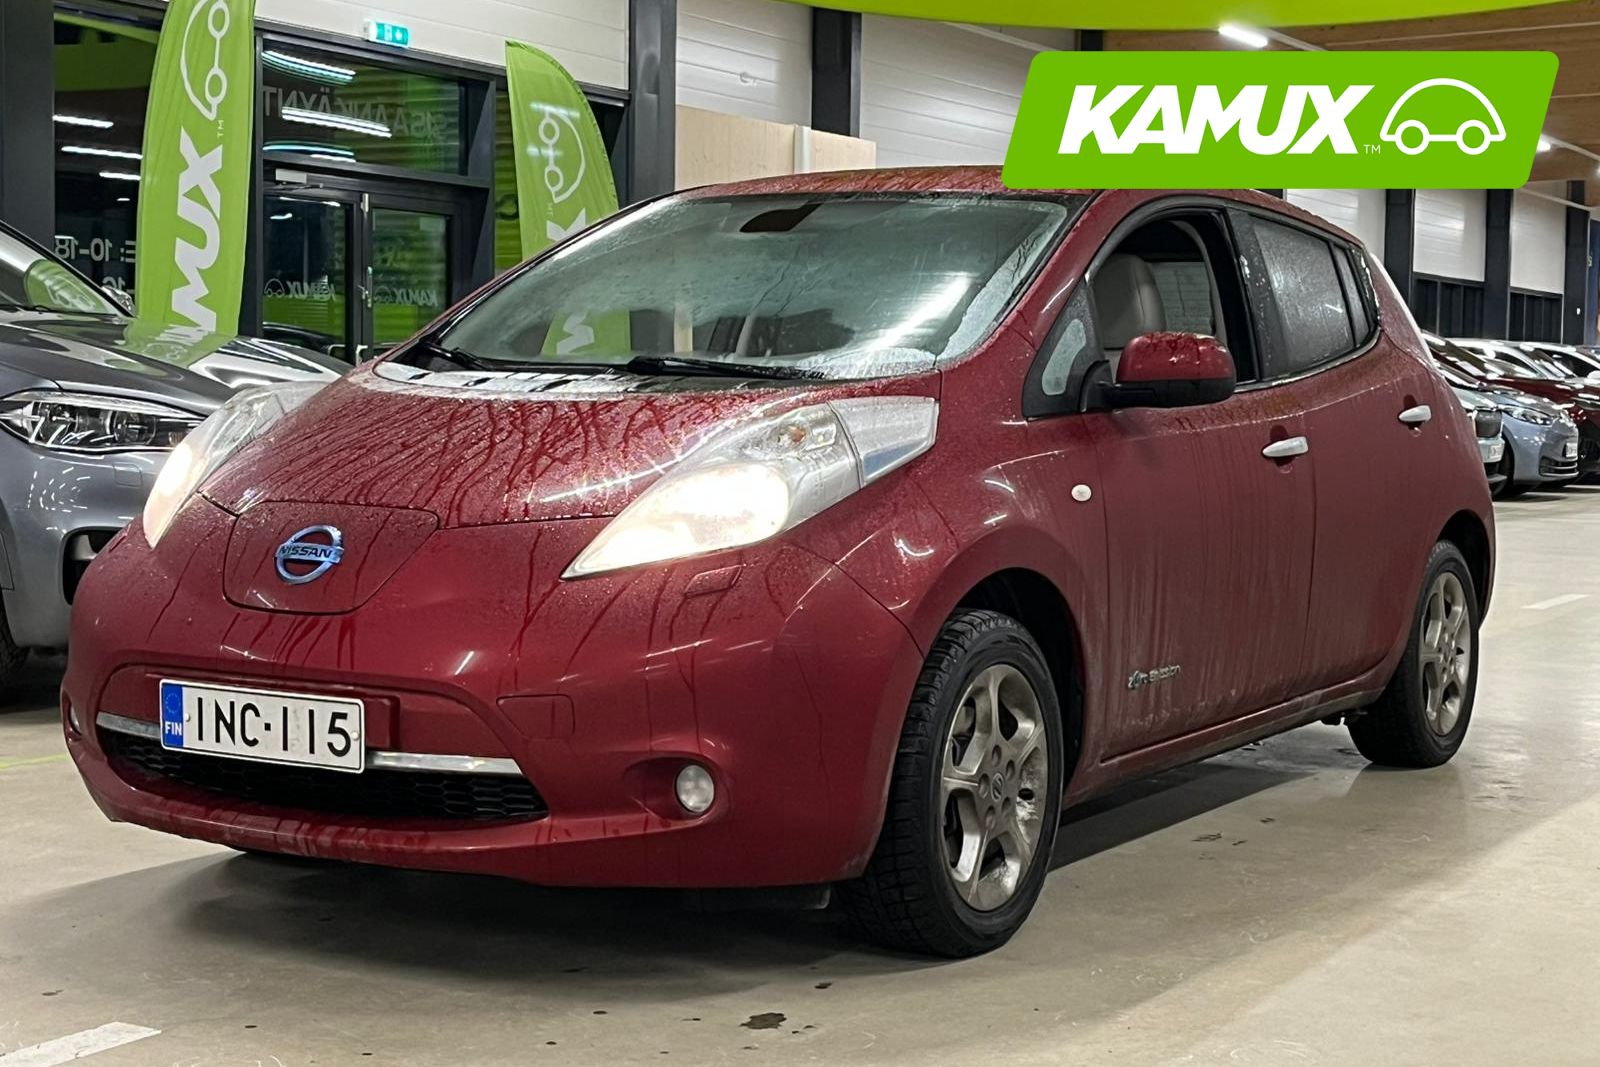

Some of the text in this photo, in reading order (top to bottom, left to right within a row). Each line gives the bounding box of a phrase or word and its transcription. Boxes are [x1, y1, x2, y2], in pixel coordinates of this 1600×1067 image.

[171, 125, 223, 333] MUX
[280, 545, 333, 559] NISSAN
[163, 696, 351, 758] FIN INC-115
